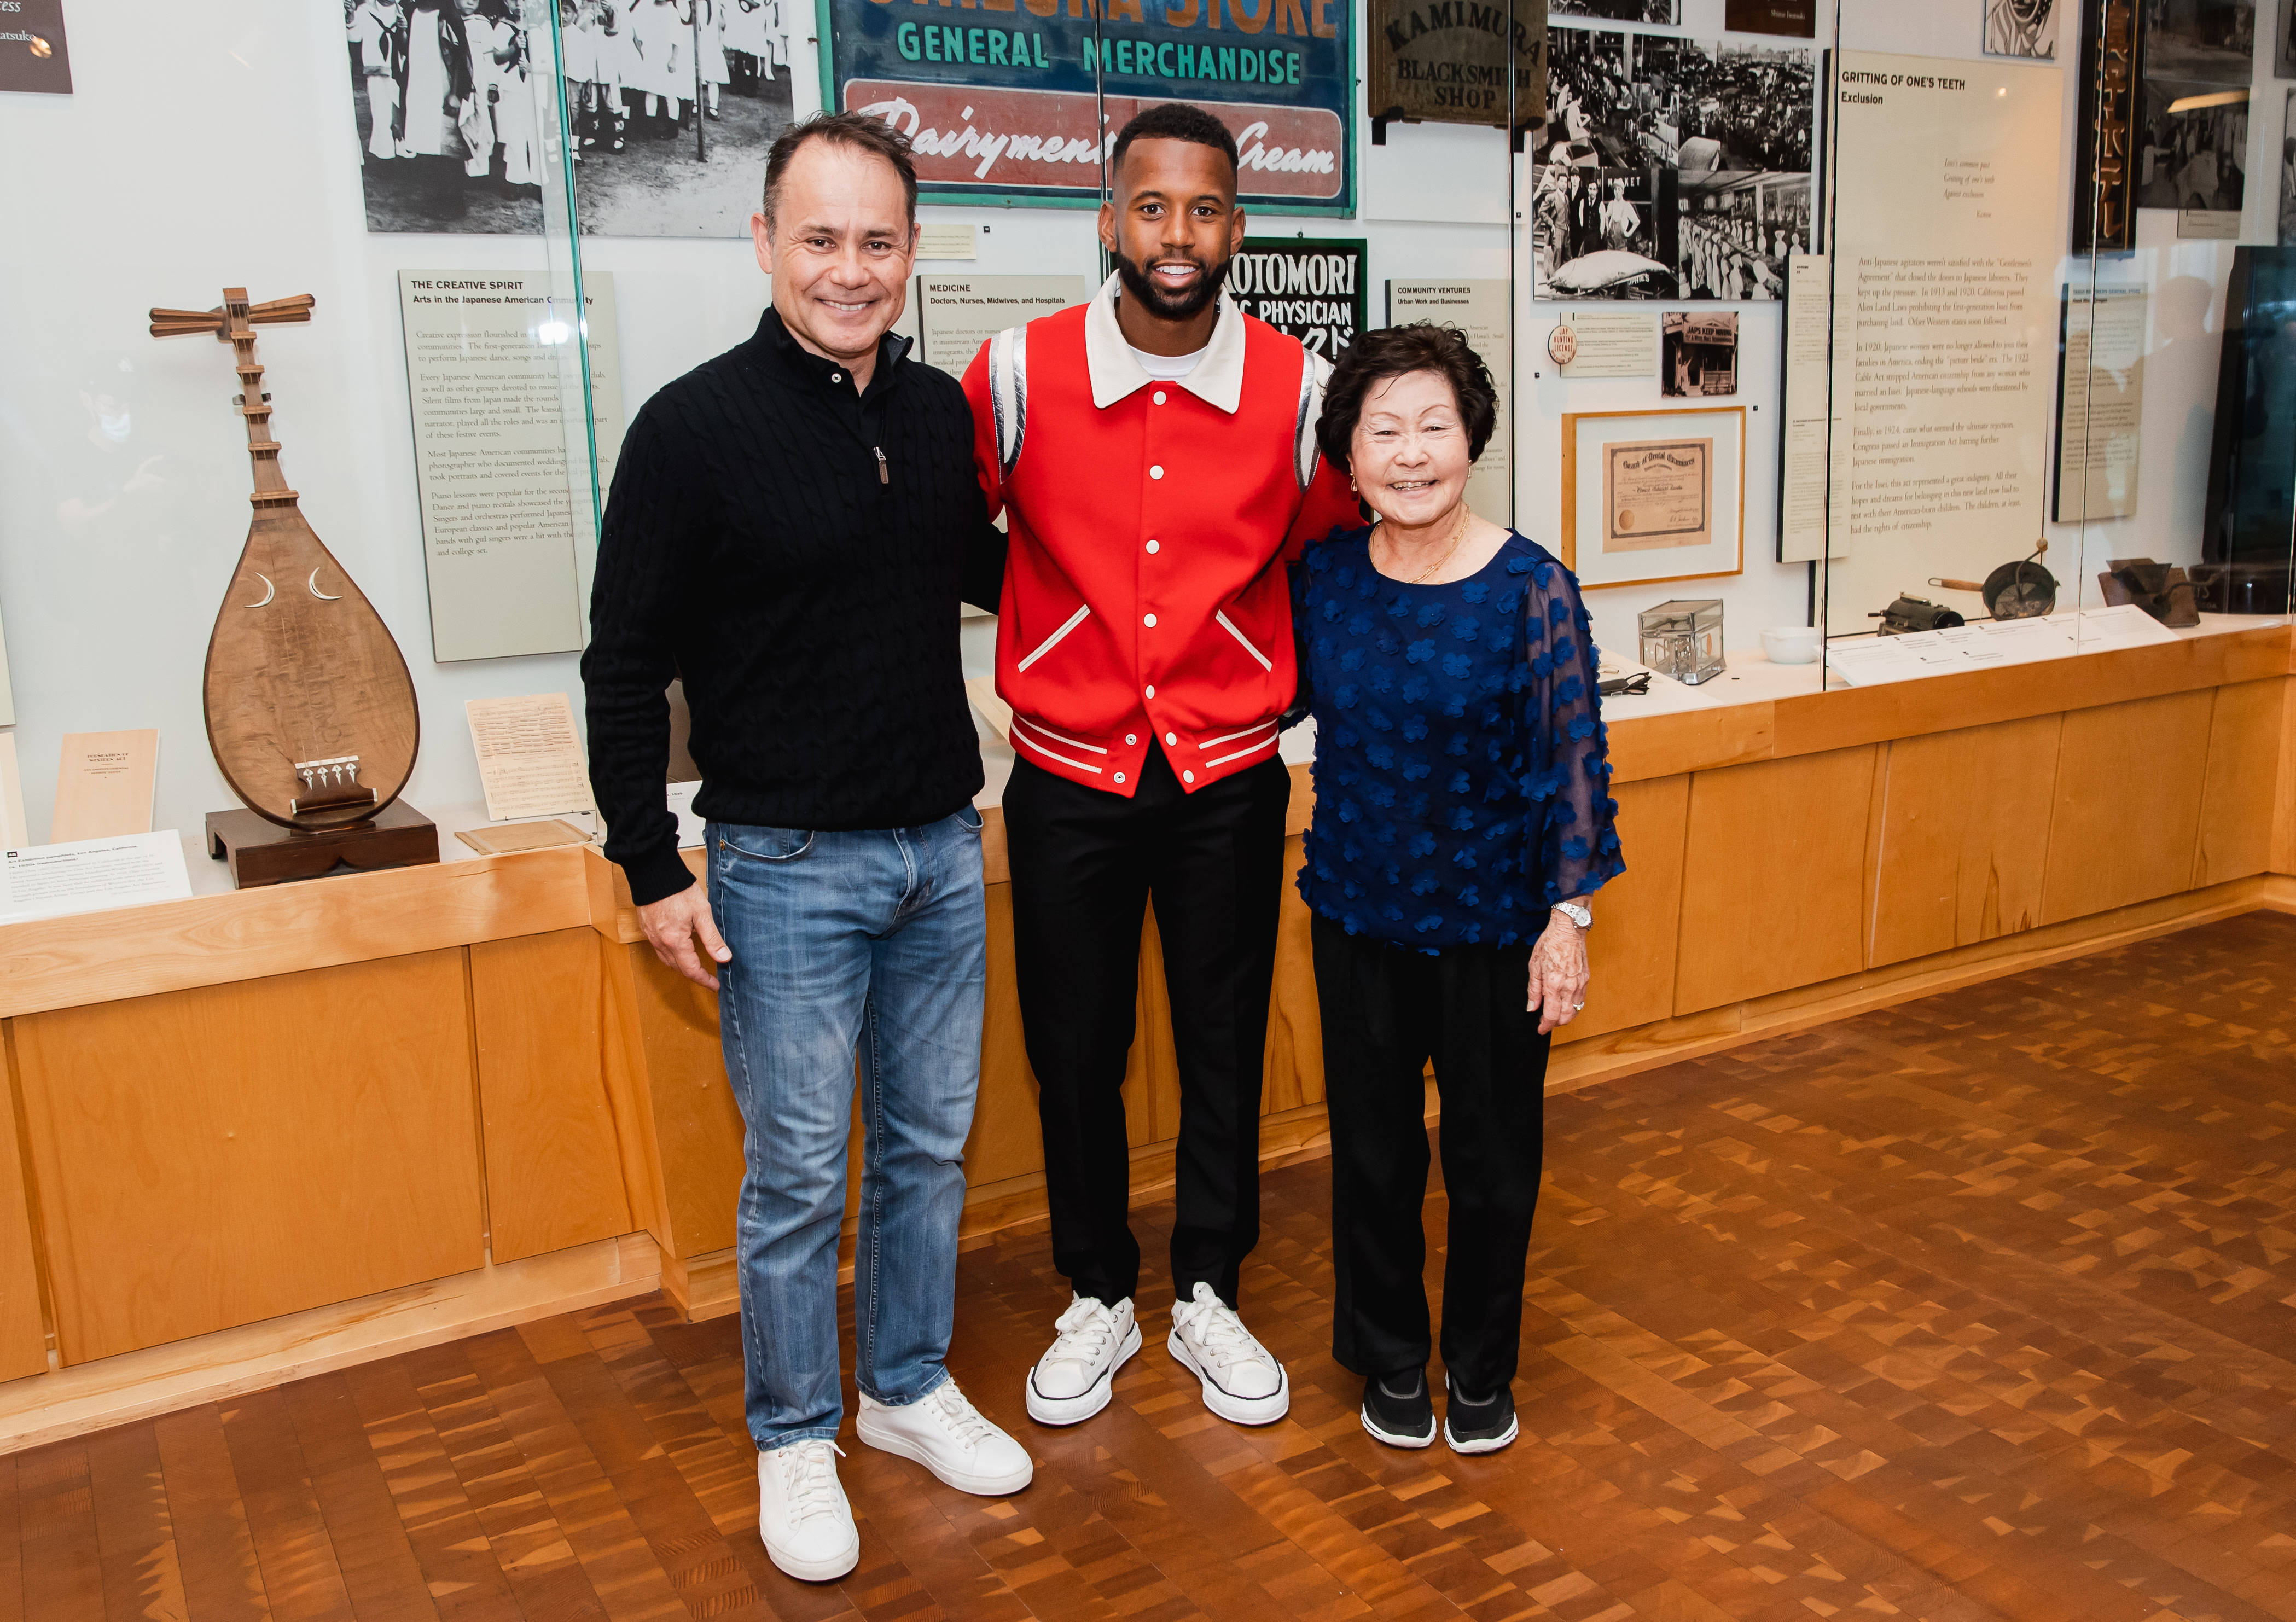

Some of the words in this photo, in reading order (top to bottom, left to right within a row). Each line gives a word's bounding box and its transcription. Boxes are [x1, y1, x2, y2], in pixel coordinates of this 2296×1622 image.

[897, 22, 1049, 68] GENERAL
[1083, 37, 1300, 85] MERCHANDISE
[1842, 72, 1887, 85] GRITTING
[1891, 75, 1904, 86] OF
[1906, 77, 1934, 88] ONE'S
[1938, 78, 1965, 90] TEETH
[1434, 86, 1496, 109] SHOP
[1841, 92, 1883, 104] Exclusion
[411, 281, 433, 289] THE
[436, 281, 486, 289] CREATIVE
[489, 281, 523, 289] SPIRIT
[413, 295, 432, 303] Arts
[434, 295, 443, 303] in
[445, 295, 459, 303] the
[462, 295, 502, 305] Japanese
[504, 295, 544, 303] American
[1259, 300, 1352, 326] PHYSICIAN
